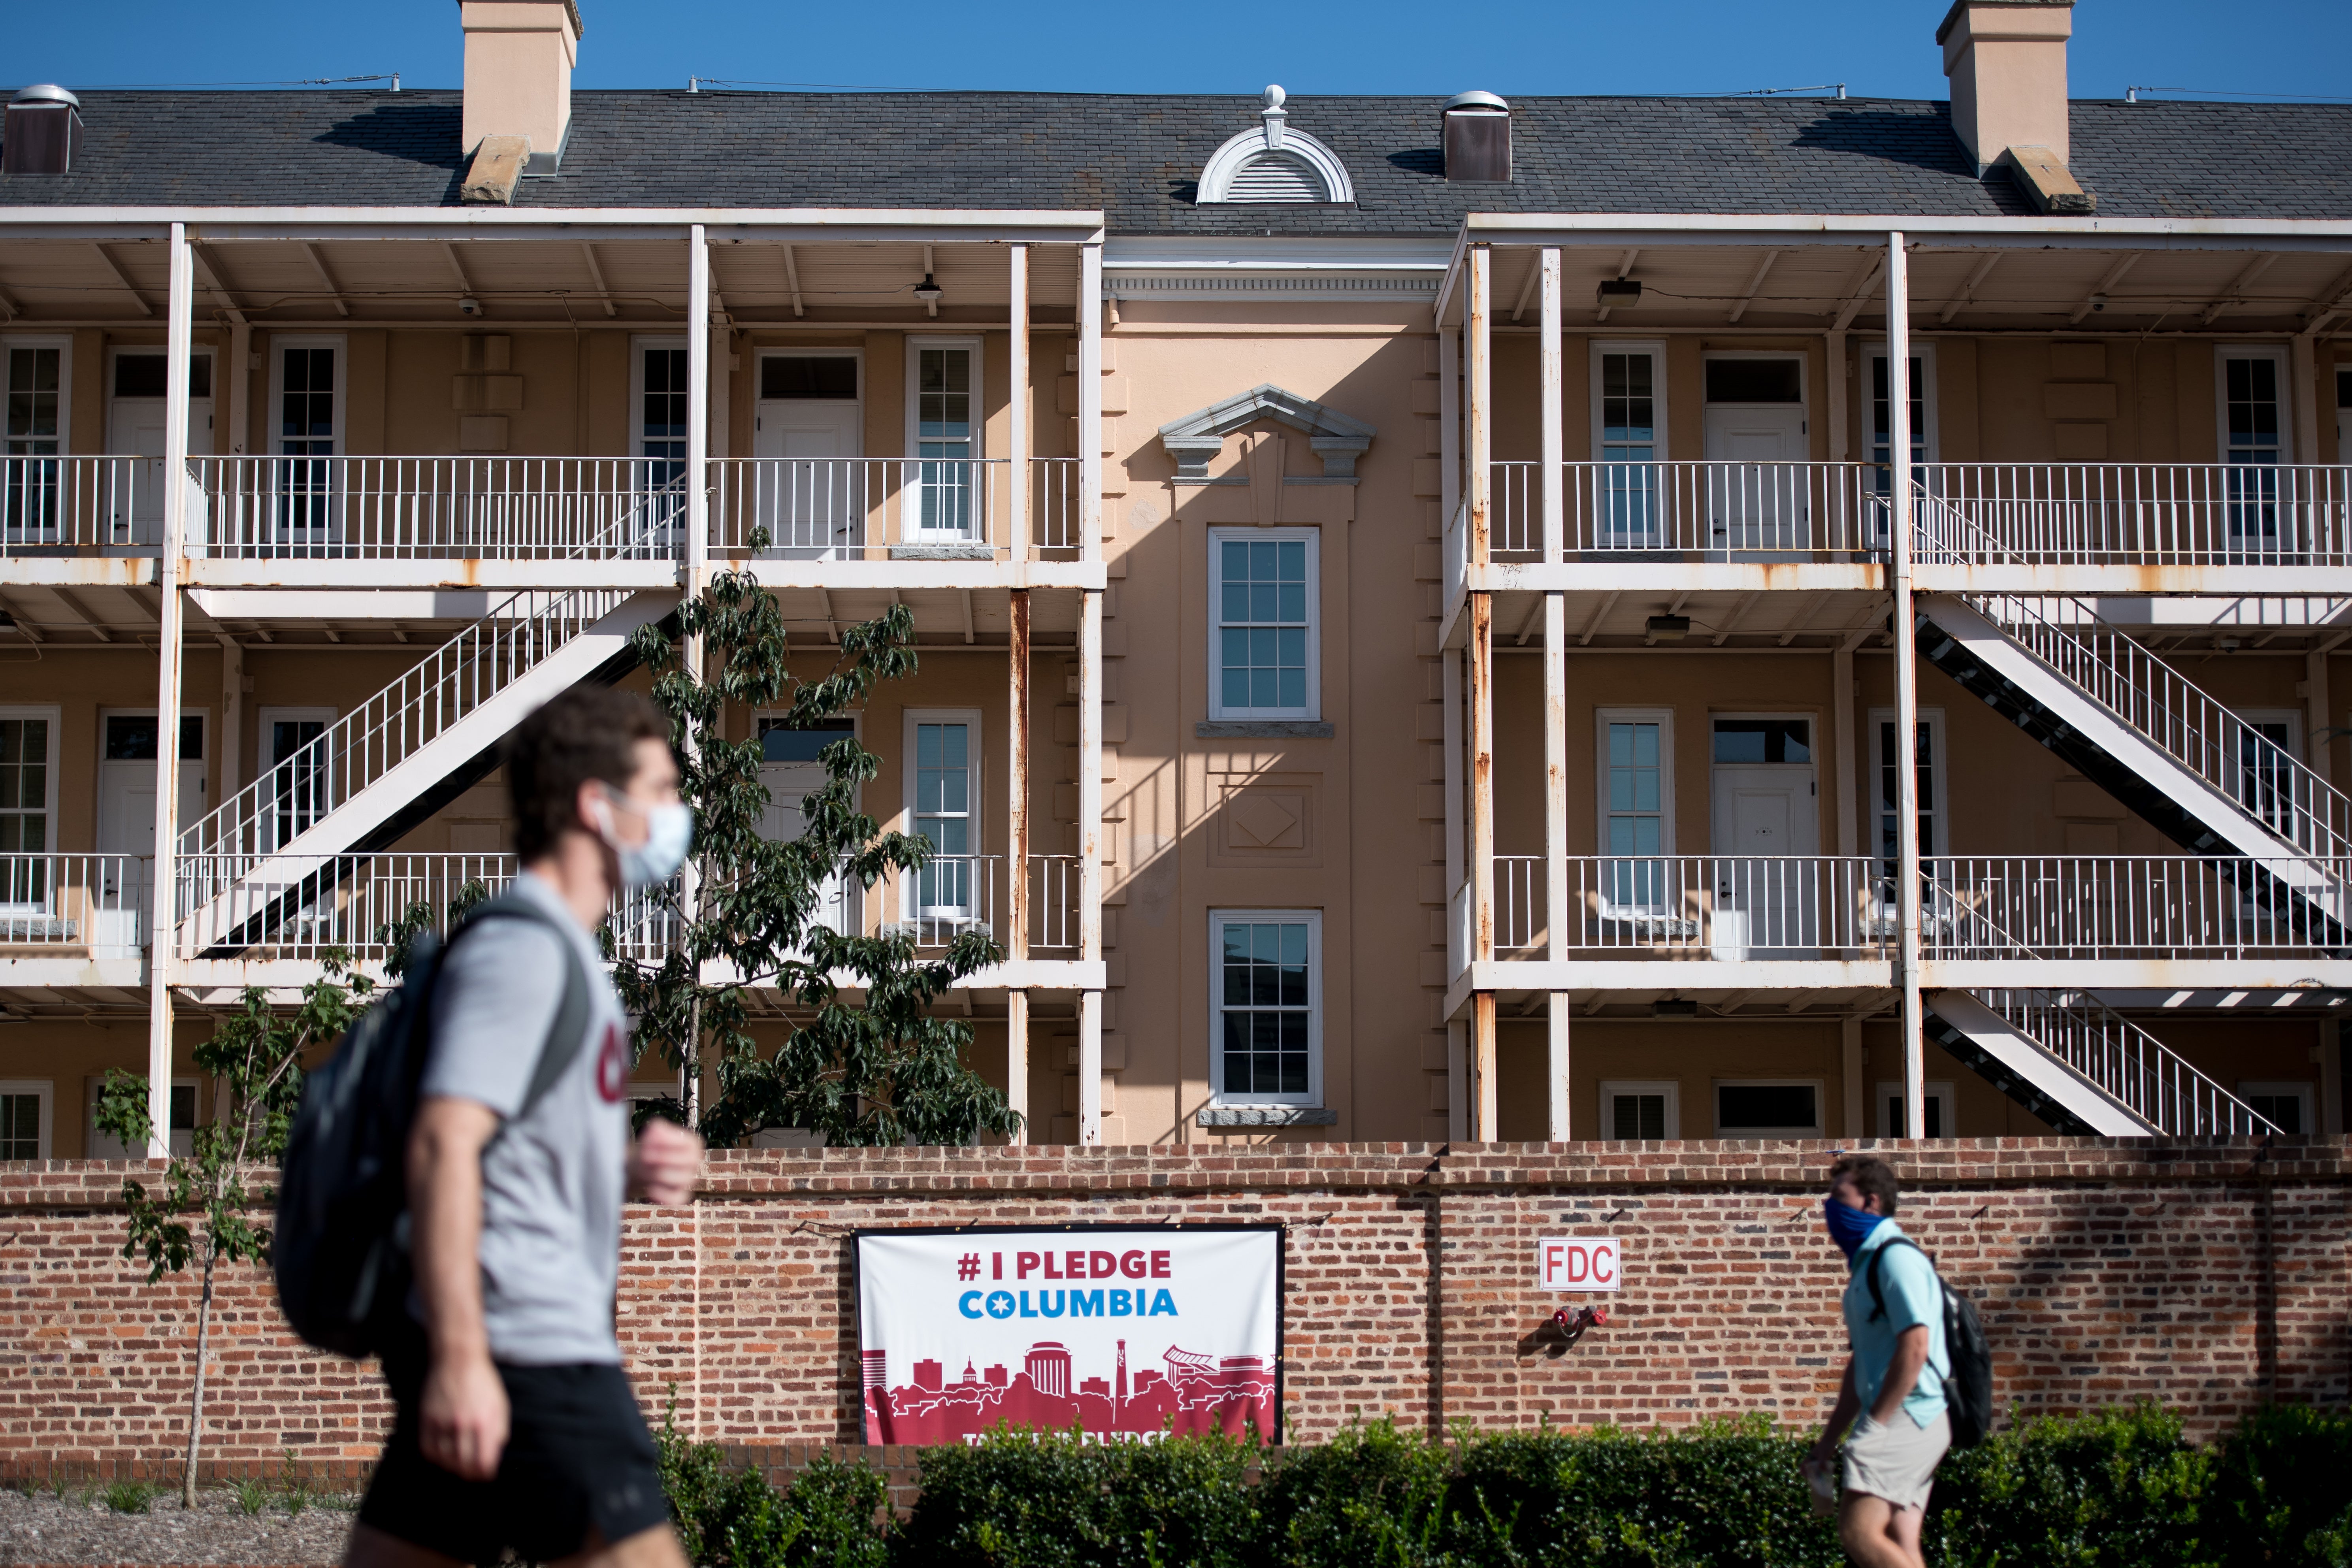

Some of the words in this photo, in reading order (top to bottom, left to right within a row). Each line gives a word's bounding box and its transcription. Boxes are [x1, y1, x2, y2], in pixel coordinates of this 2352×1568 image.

[1017, 1250, 1171, 1279] PLEDGE
[1547, 1246, 1613, 1283] FDC
[958, 1288, 1179, 1319] COLUMBIA
